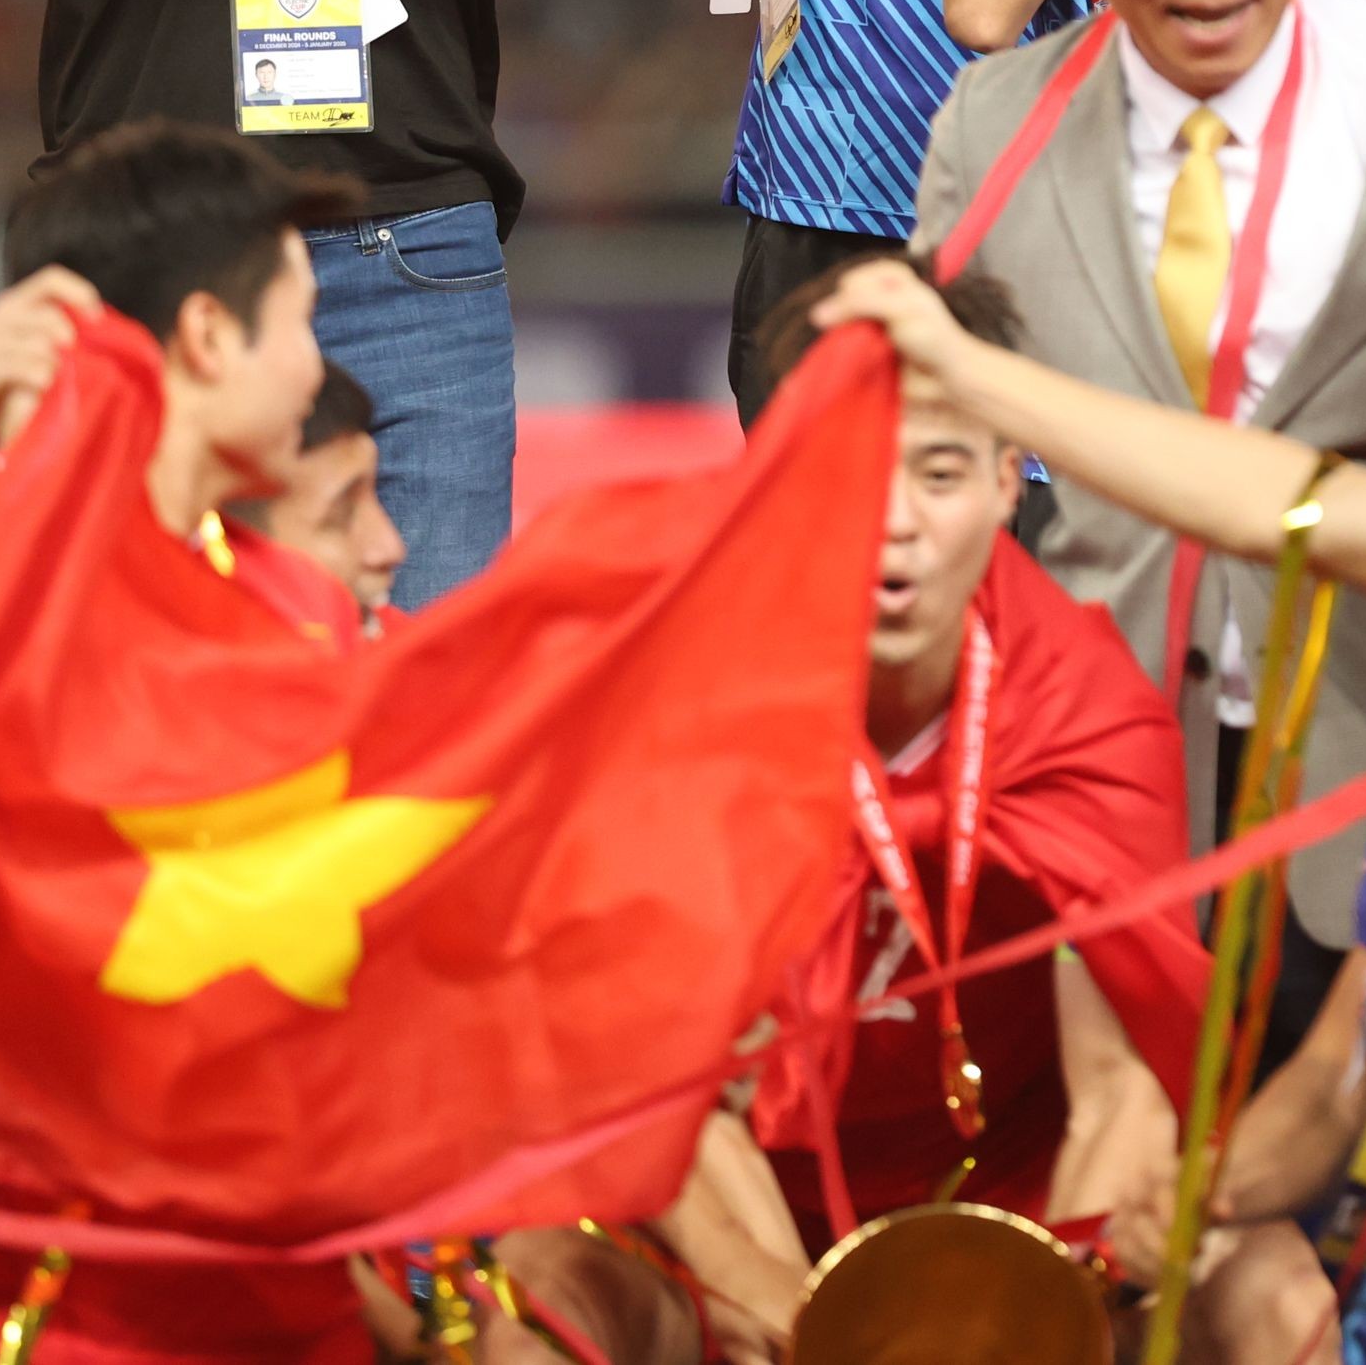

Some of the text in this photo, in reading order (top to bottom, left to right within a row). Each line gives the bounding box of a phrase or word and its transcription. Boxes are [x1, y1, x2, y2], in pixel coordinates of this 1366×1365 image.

[264, 31, 337, 42] FINAL ROUNDS
[288, 112, 320, 121] TEAM
